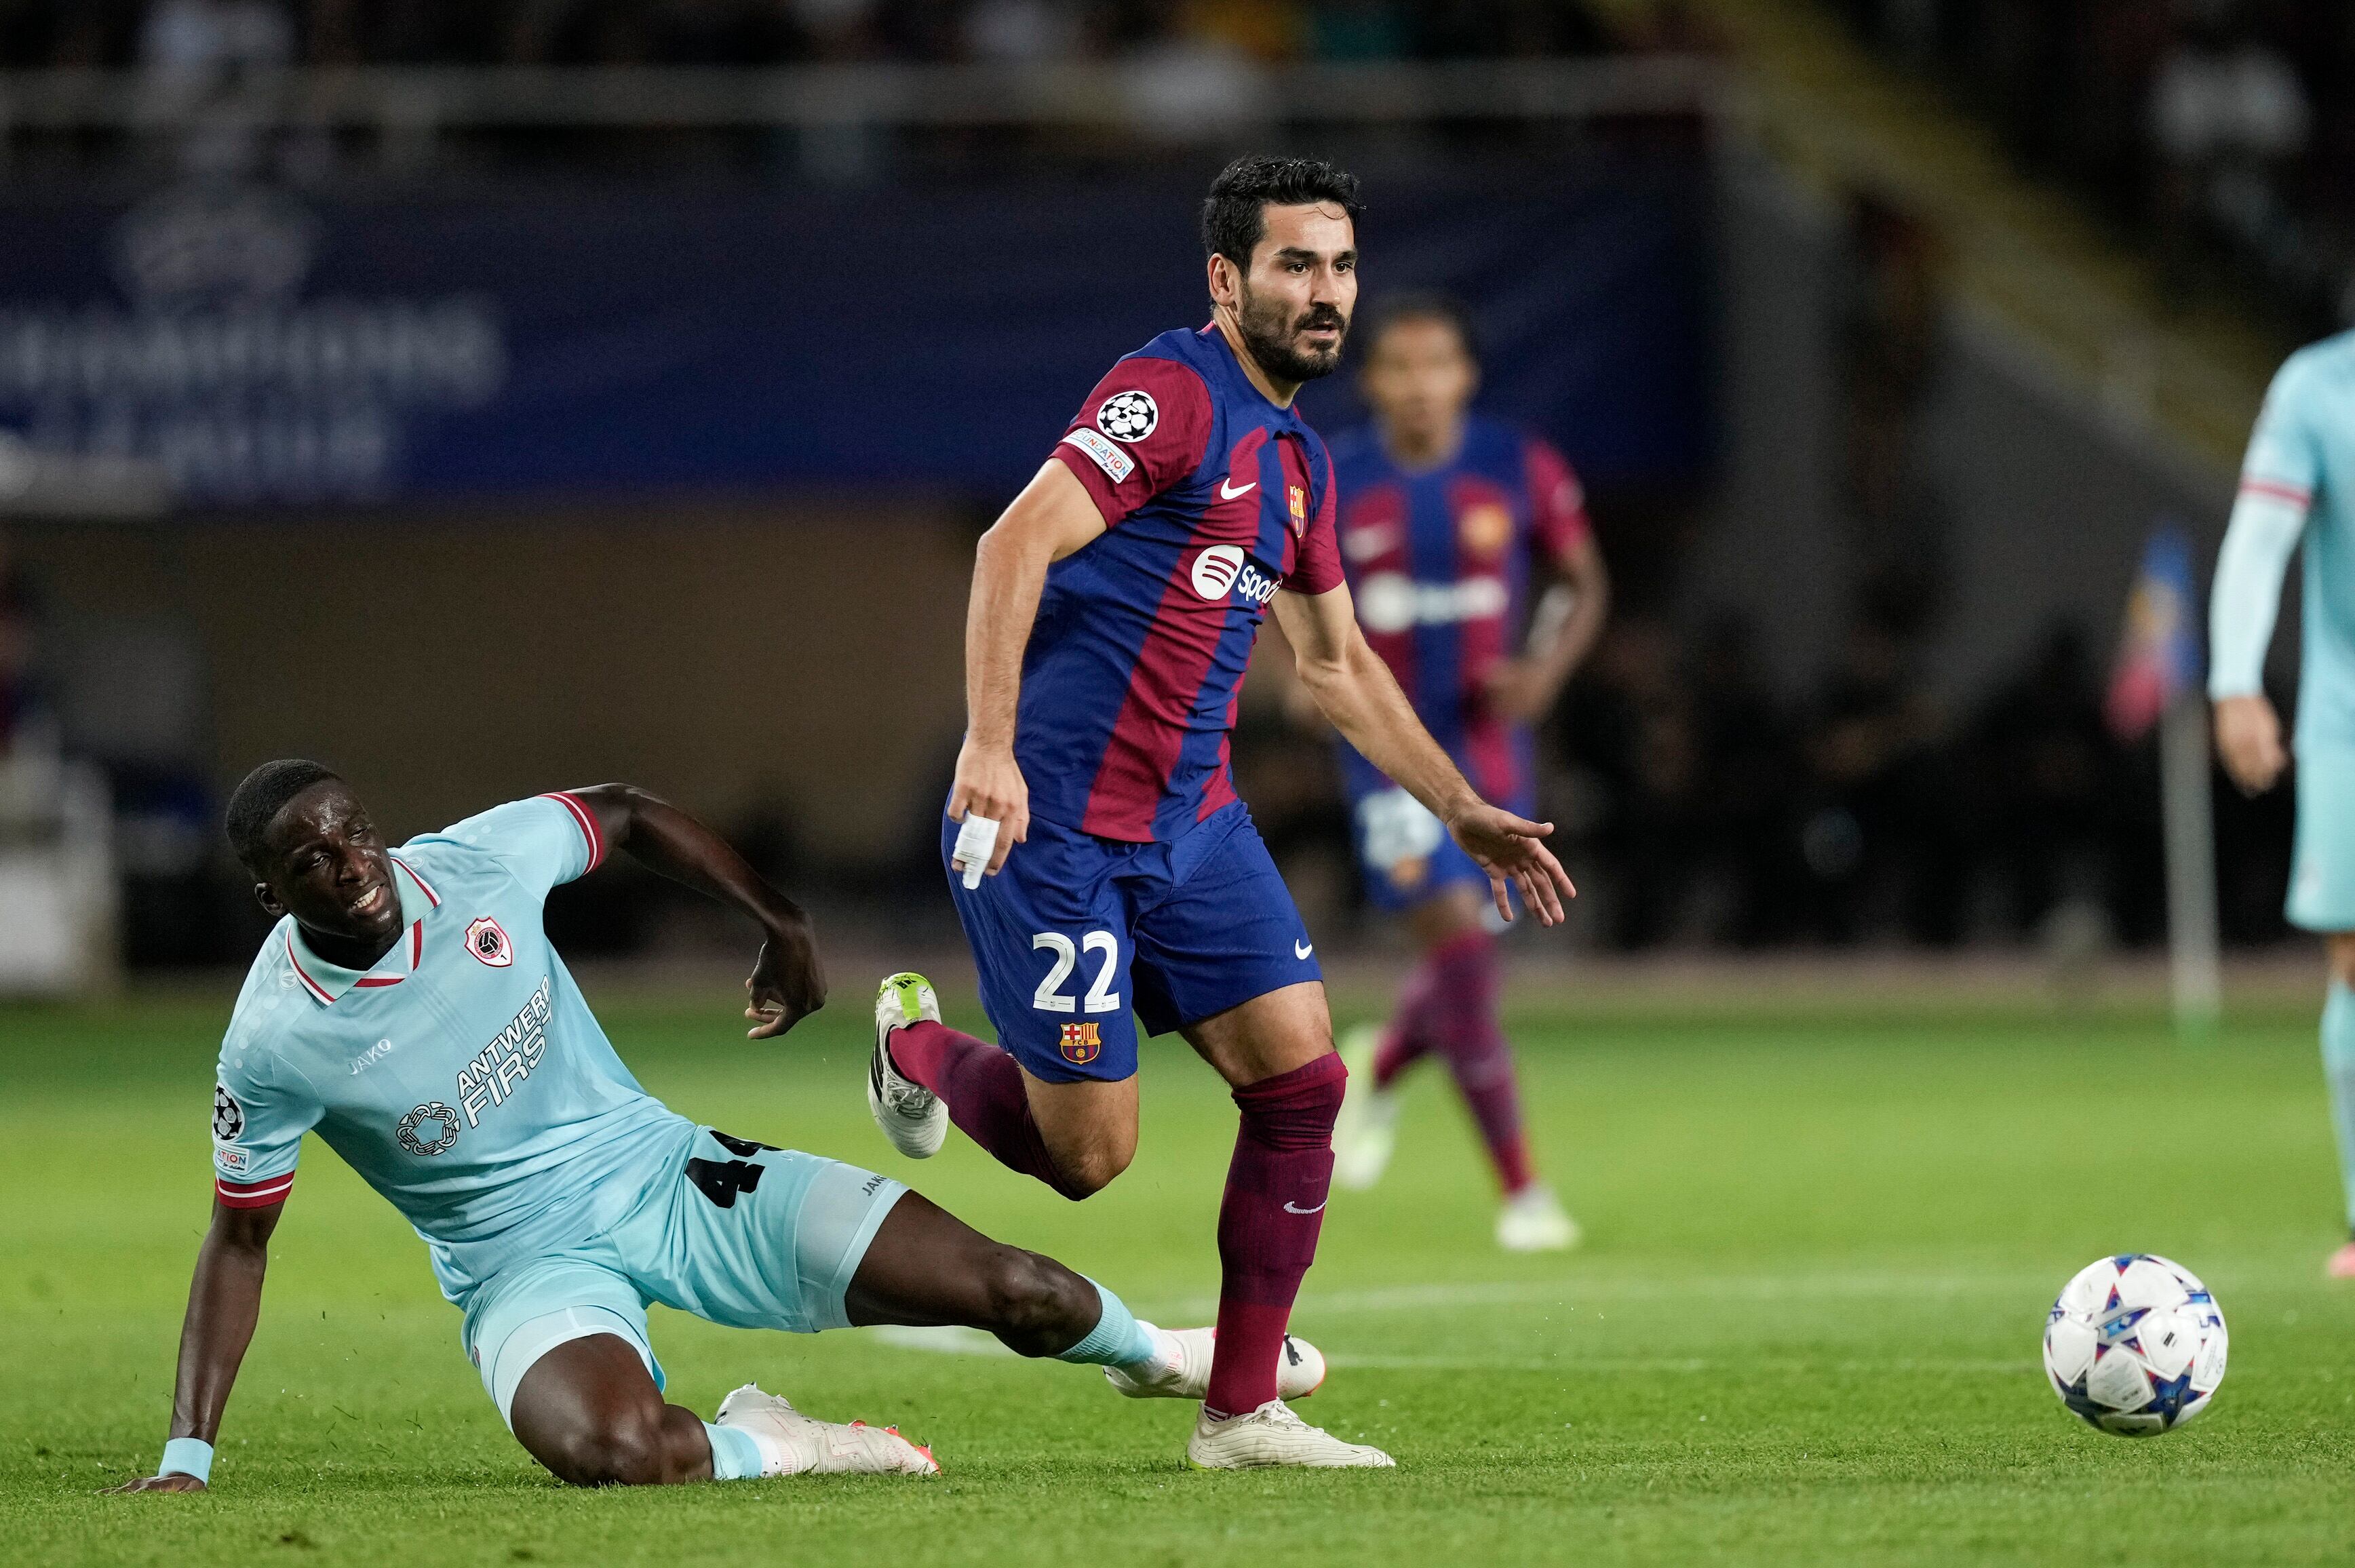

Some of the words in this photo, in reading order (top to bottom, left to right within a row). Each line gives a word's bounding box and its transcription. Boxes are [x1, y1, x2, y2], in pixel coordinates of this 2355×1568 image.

[1115, 404, 1139, 423] 5
[1033, 930, 1120, 1013] 22
[349, 1038, 391, 1076] JAKO
[457, 975, 551, 1100] ANTWERP
[462, 995, 553, 1129] FIRST
